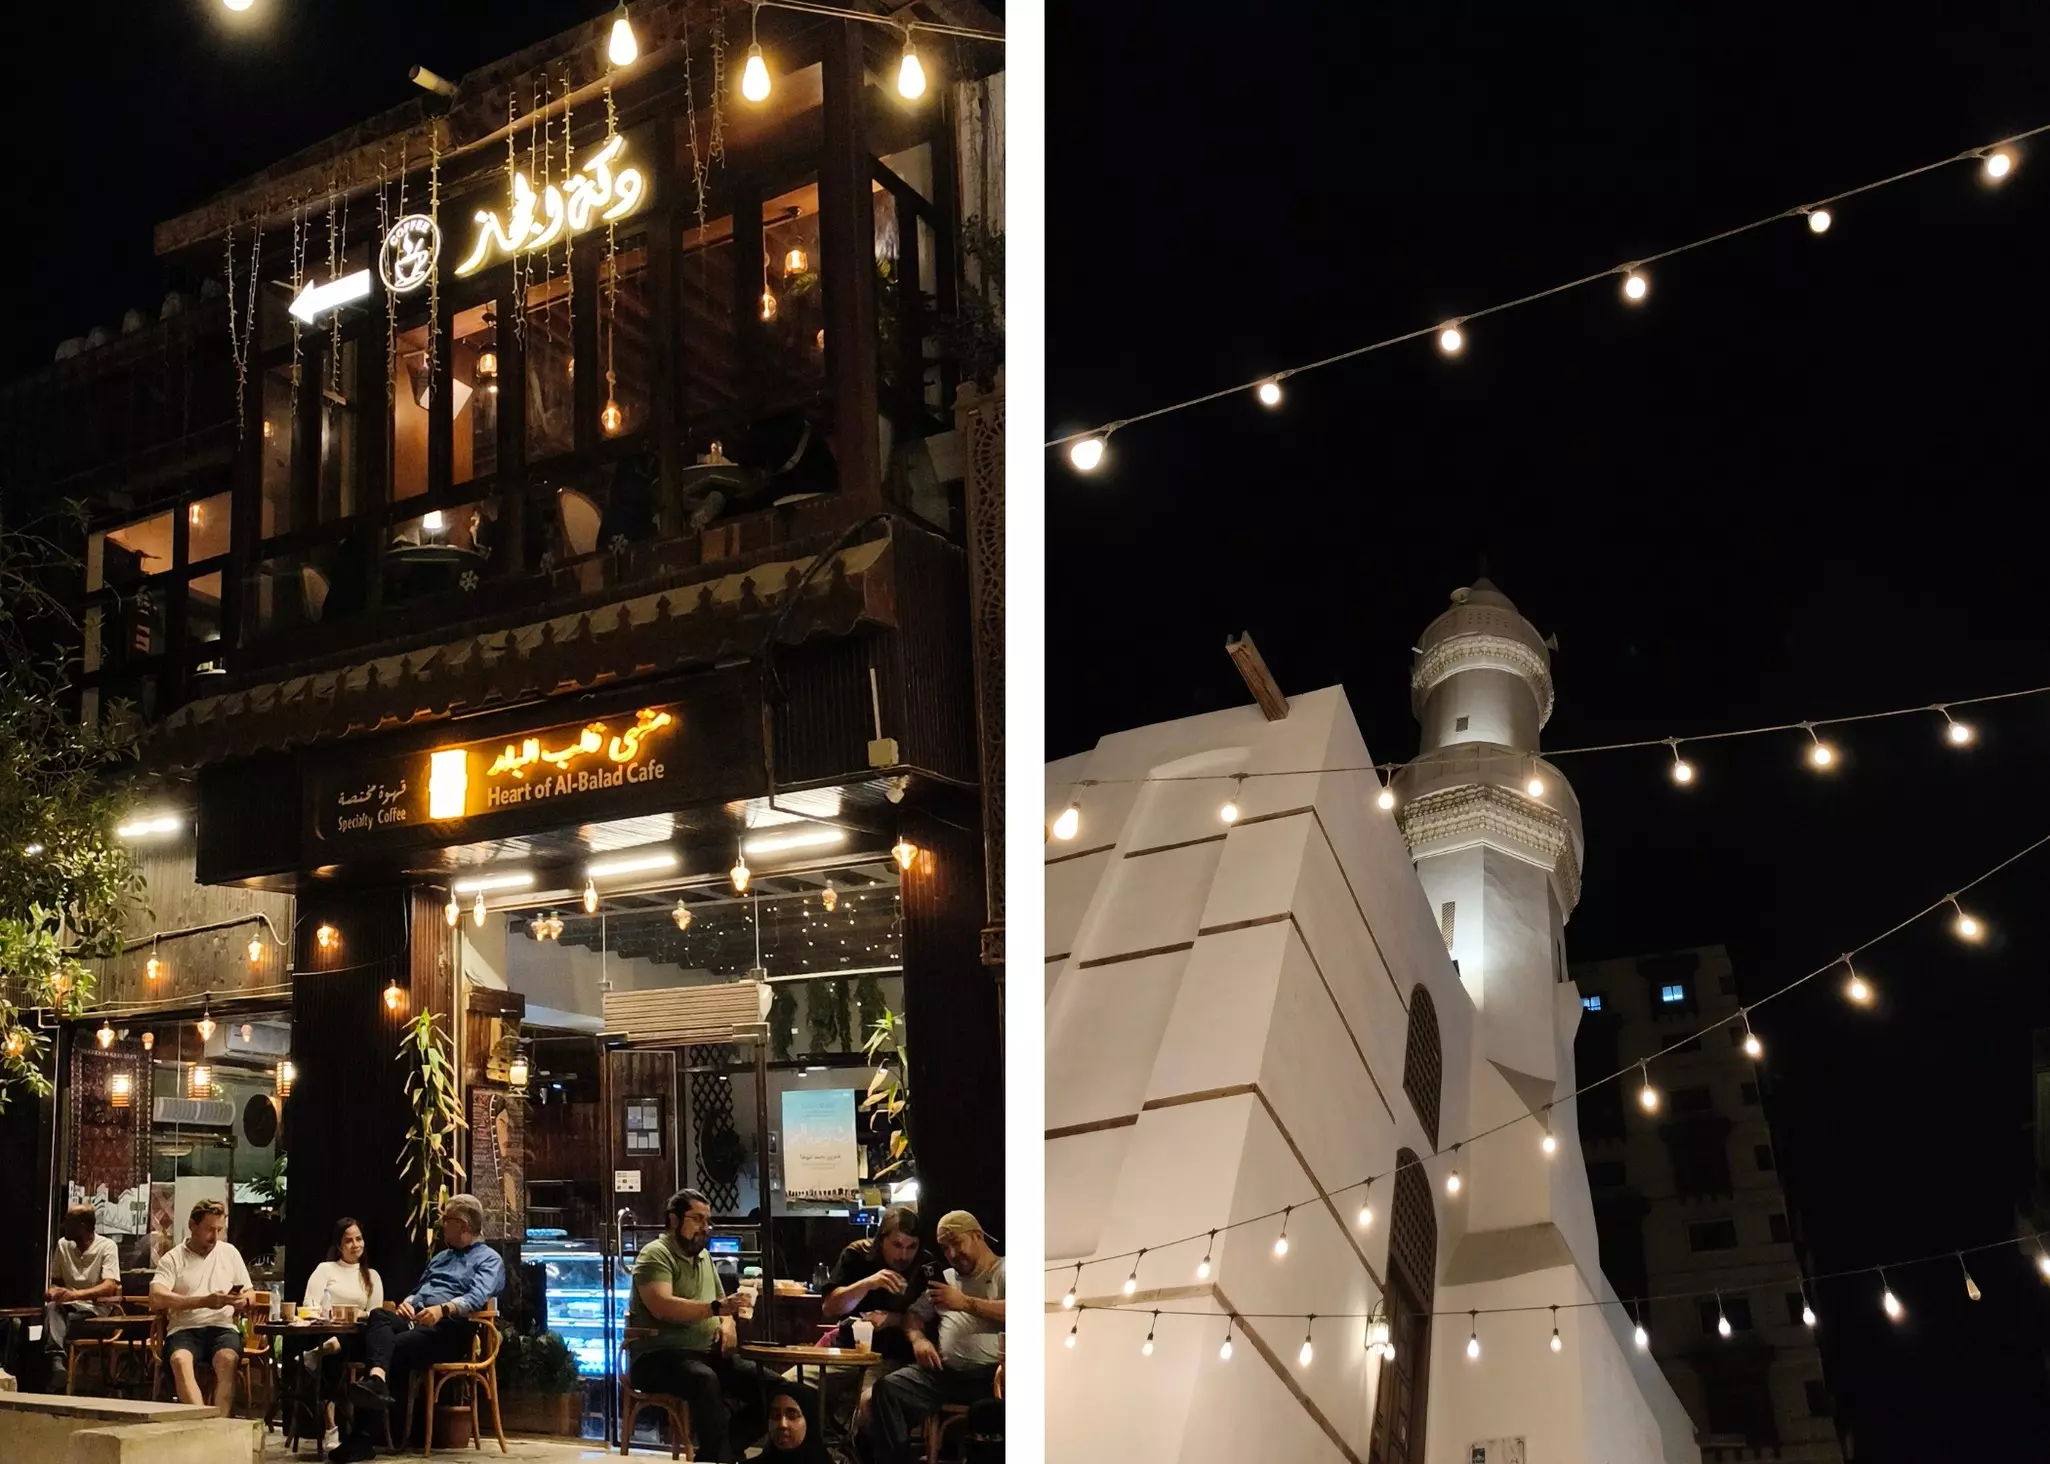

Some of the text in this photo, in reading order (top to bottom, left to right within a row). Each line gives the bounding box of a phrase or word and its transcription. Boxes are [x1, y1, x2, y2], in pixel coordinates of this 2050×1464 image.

[389, 219, 431, 247] COFFEE
[486, 738, 540, 779] البلد
[540, 721, 608, 770] قلب
[338, 779, 407, 806] قهوة مختصة
[487, 759, 665, 807] Heart of Al-Balad Cafe
[338, 807, 406, 833] Specialty Coffee
